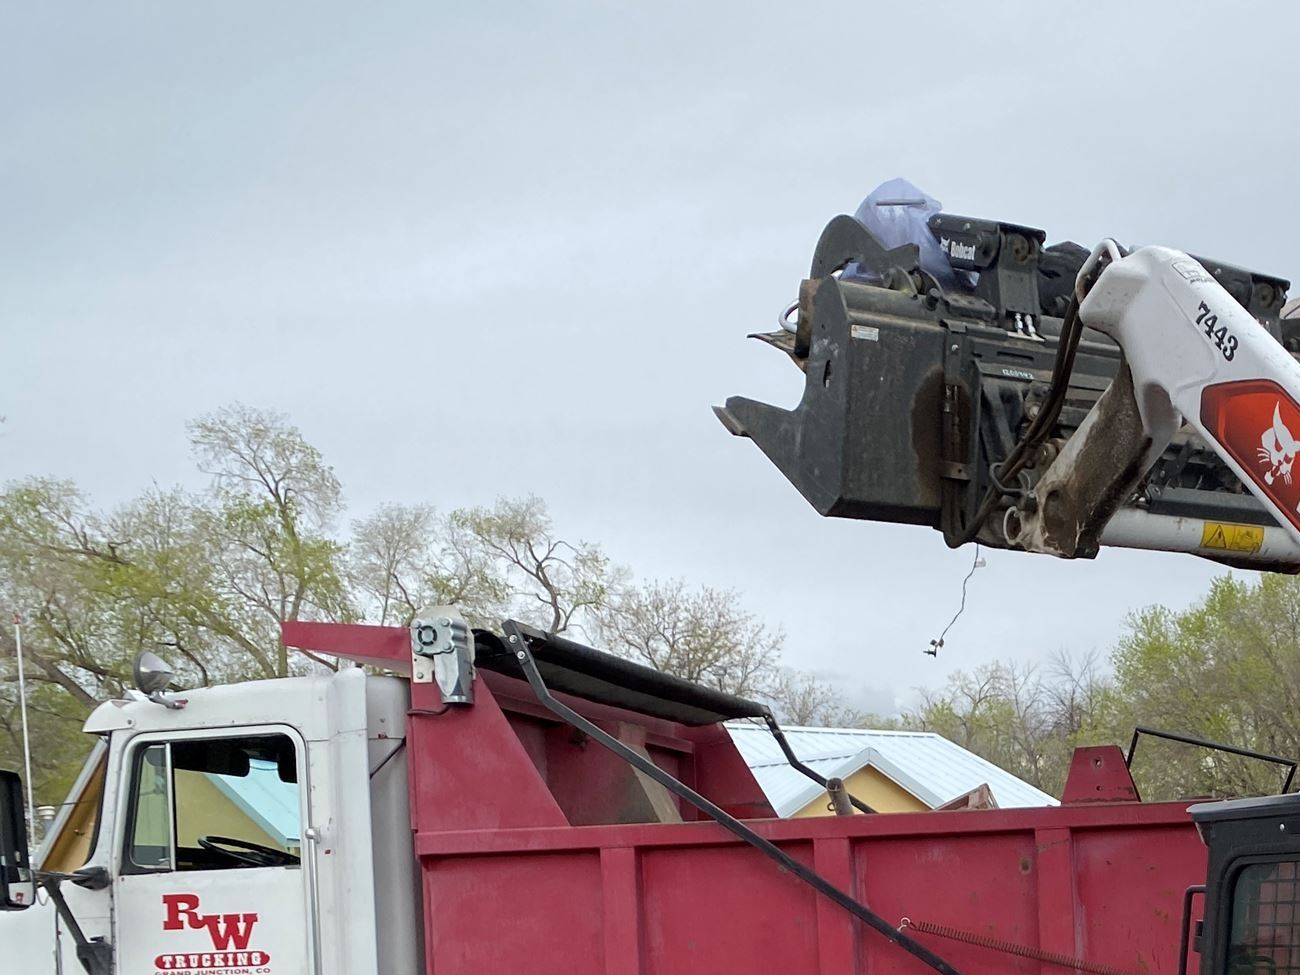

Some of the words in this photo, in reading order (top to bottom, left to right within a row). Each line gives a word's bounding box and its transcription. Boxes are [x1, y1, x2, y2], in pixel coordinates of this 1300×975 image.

[950, 241, 976, 260] Bobcat
[1195, 300, 1239, 362] 7443
[162, 893, 258, 950] RW
[162, 952, 262, 969] TRUCKING
[194, 968, 253, 975] JUNCTION,
